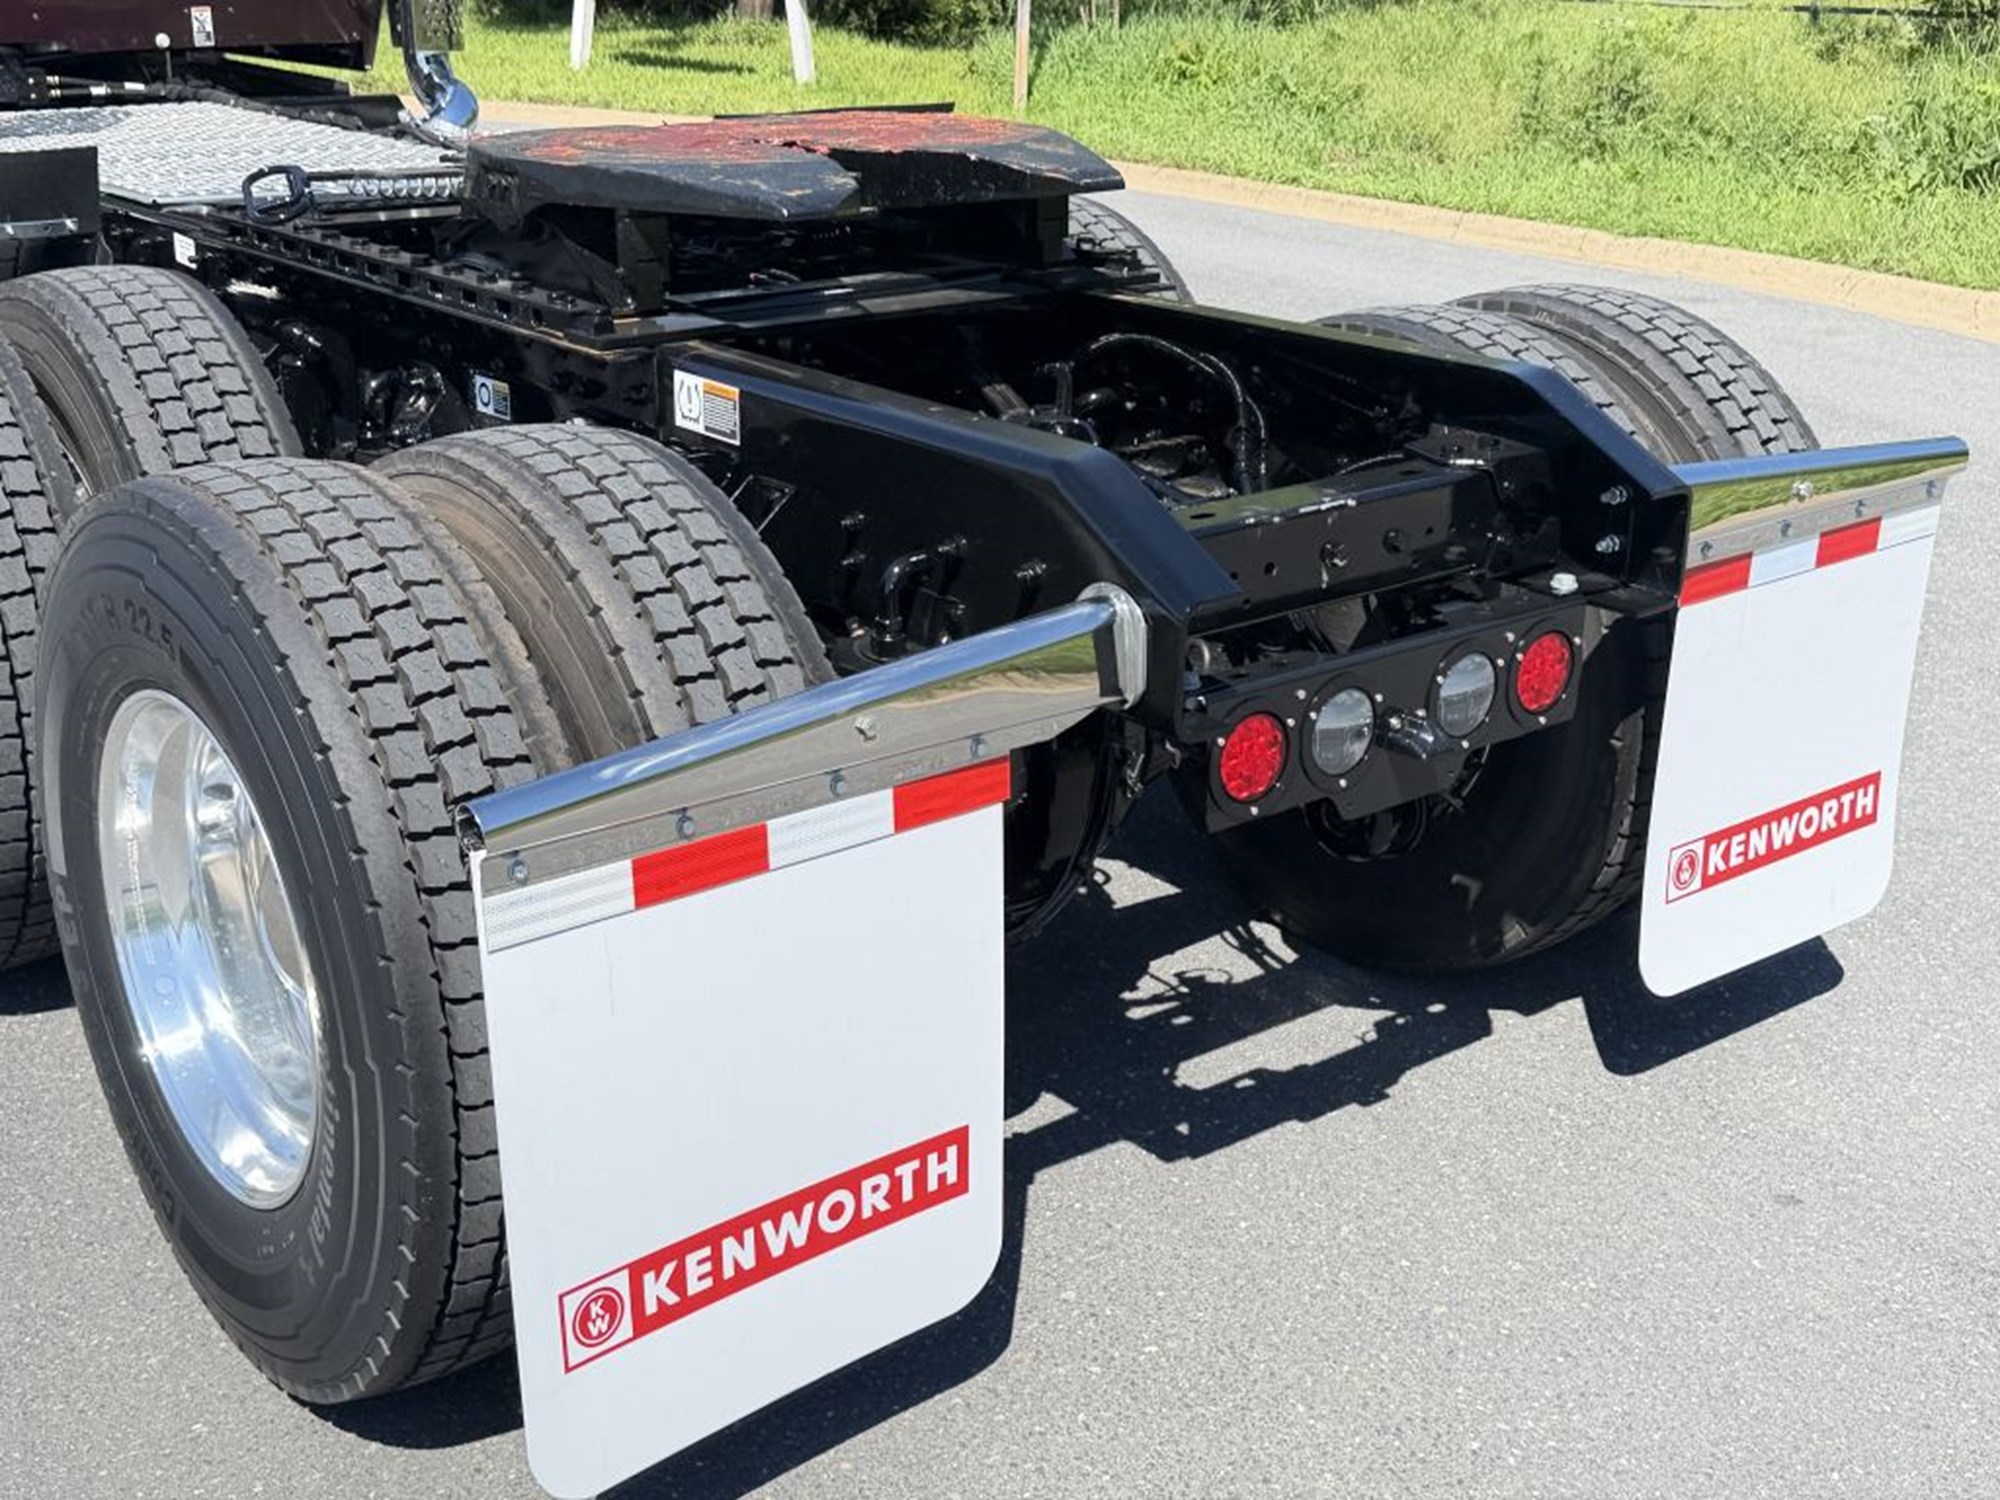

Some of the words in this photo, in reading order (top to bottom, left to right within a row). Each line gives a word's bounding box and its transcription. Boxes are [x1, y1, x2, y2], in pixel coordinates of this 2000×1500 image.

[123, 597, 176, 662] 22.5
[1707, 784, 1875, 876] KENWORTH
[642, 1144, 958, 1316] KENWORTH
